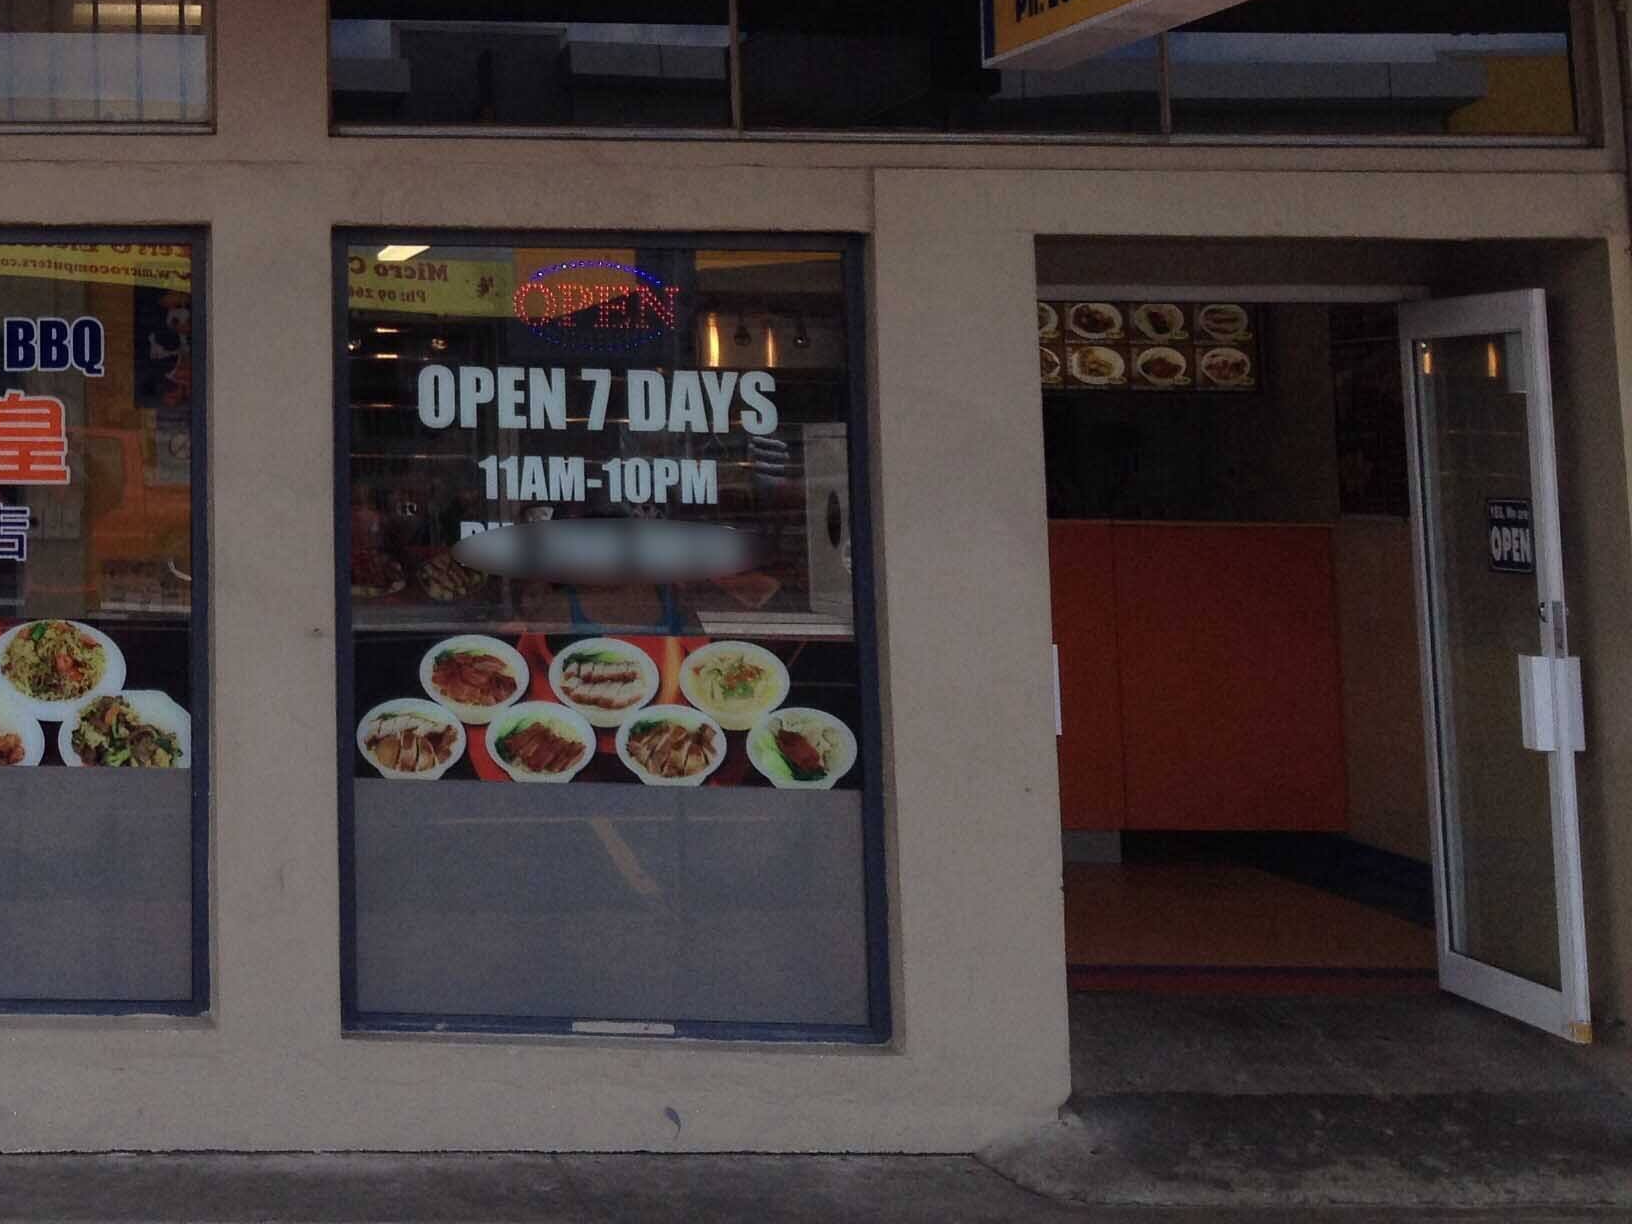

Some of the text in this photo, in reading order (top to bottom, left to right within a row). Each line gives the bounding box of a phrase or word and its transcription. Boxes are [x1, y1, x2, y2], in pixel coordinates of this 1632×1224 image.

[513, 283, 680, 331] OPEN
[4, 317, 105, 377] BBQ
[417, 364, 779, 435] OPEN 7 DAYS
[478, 455, 718, 504] 11AM-10PM
[1490, 526, 1533, 563] OPEN
